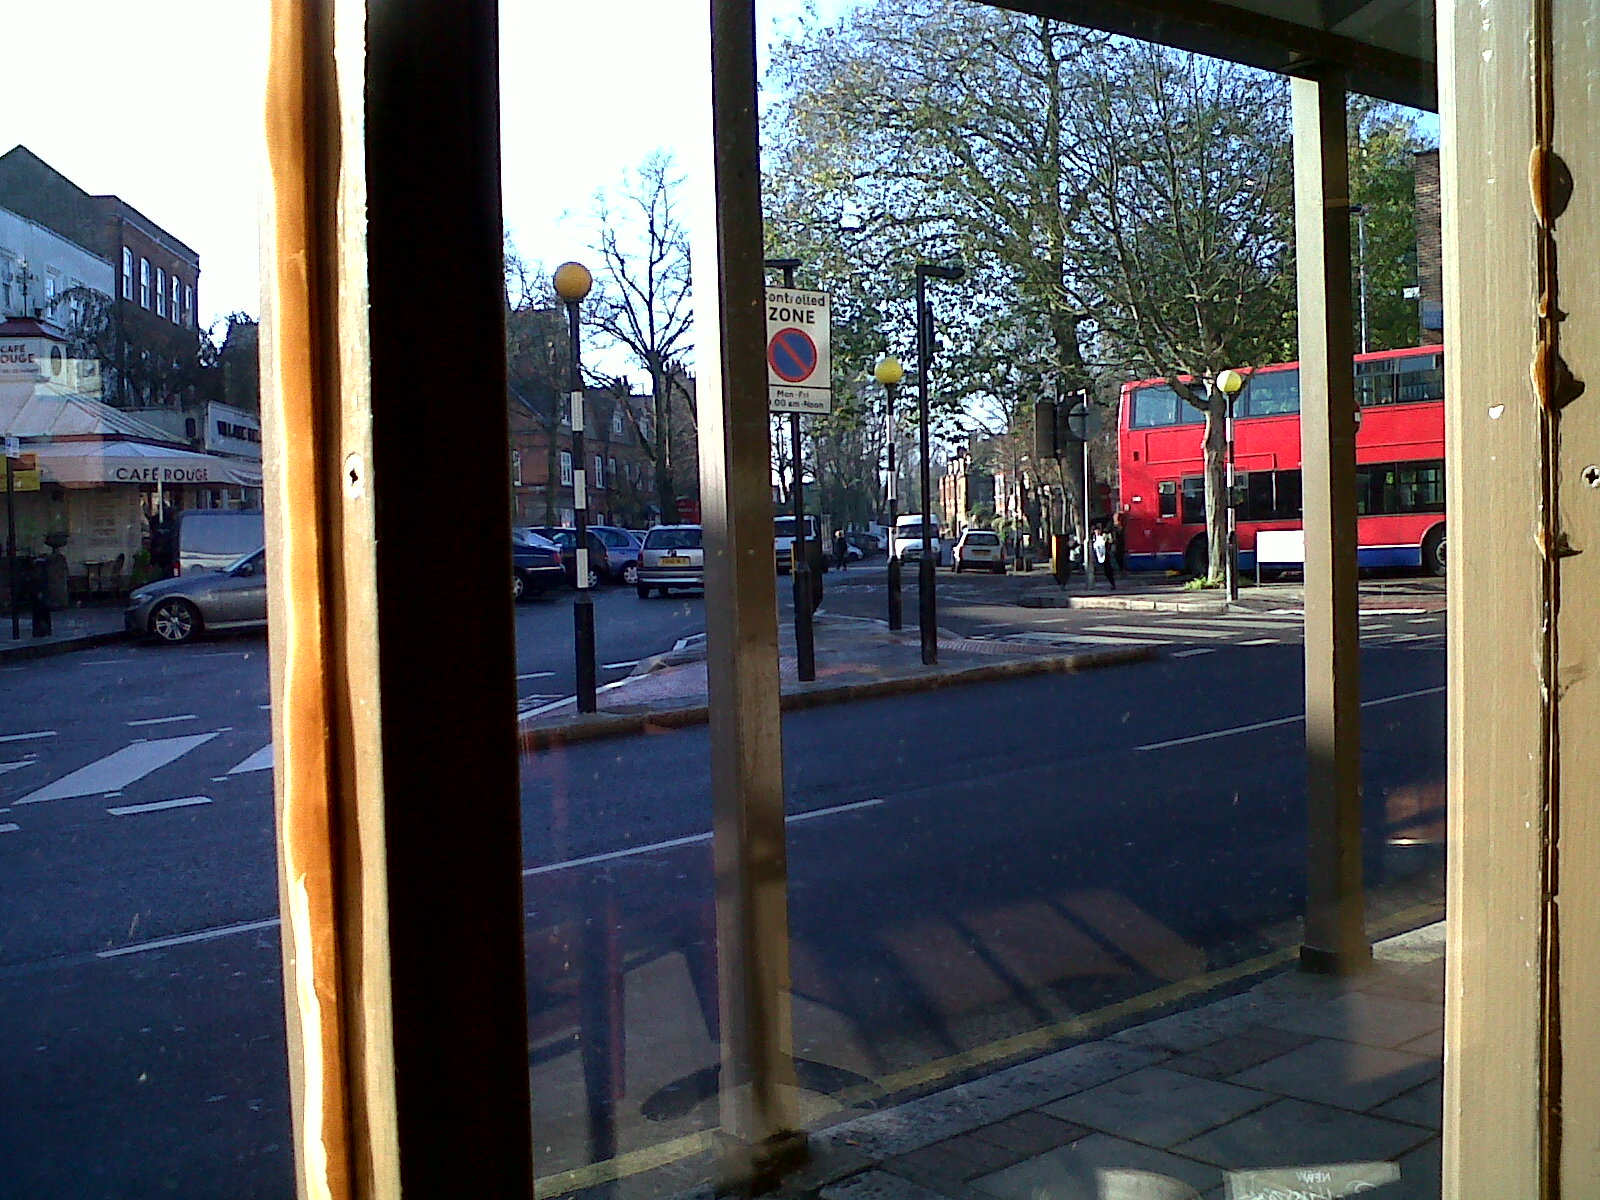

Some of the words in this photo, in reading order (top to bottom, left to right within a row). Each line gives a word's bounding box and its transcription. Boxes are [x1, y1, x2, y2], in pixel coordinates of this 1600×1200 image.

[766, 291, 825, 307] ontrolled
[769, 306, 815, 324] ZONE
[0, 353, 35, 364] OUGE
[163, 468, 208, 481] ROUGE
